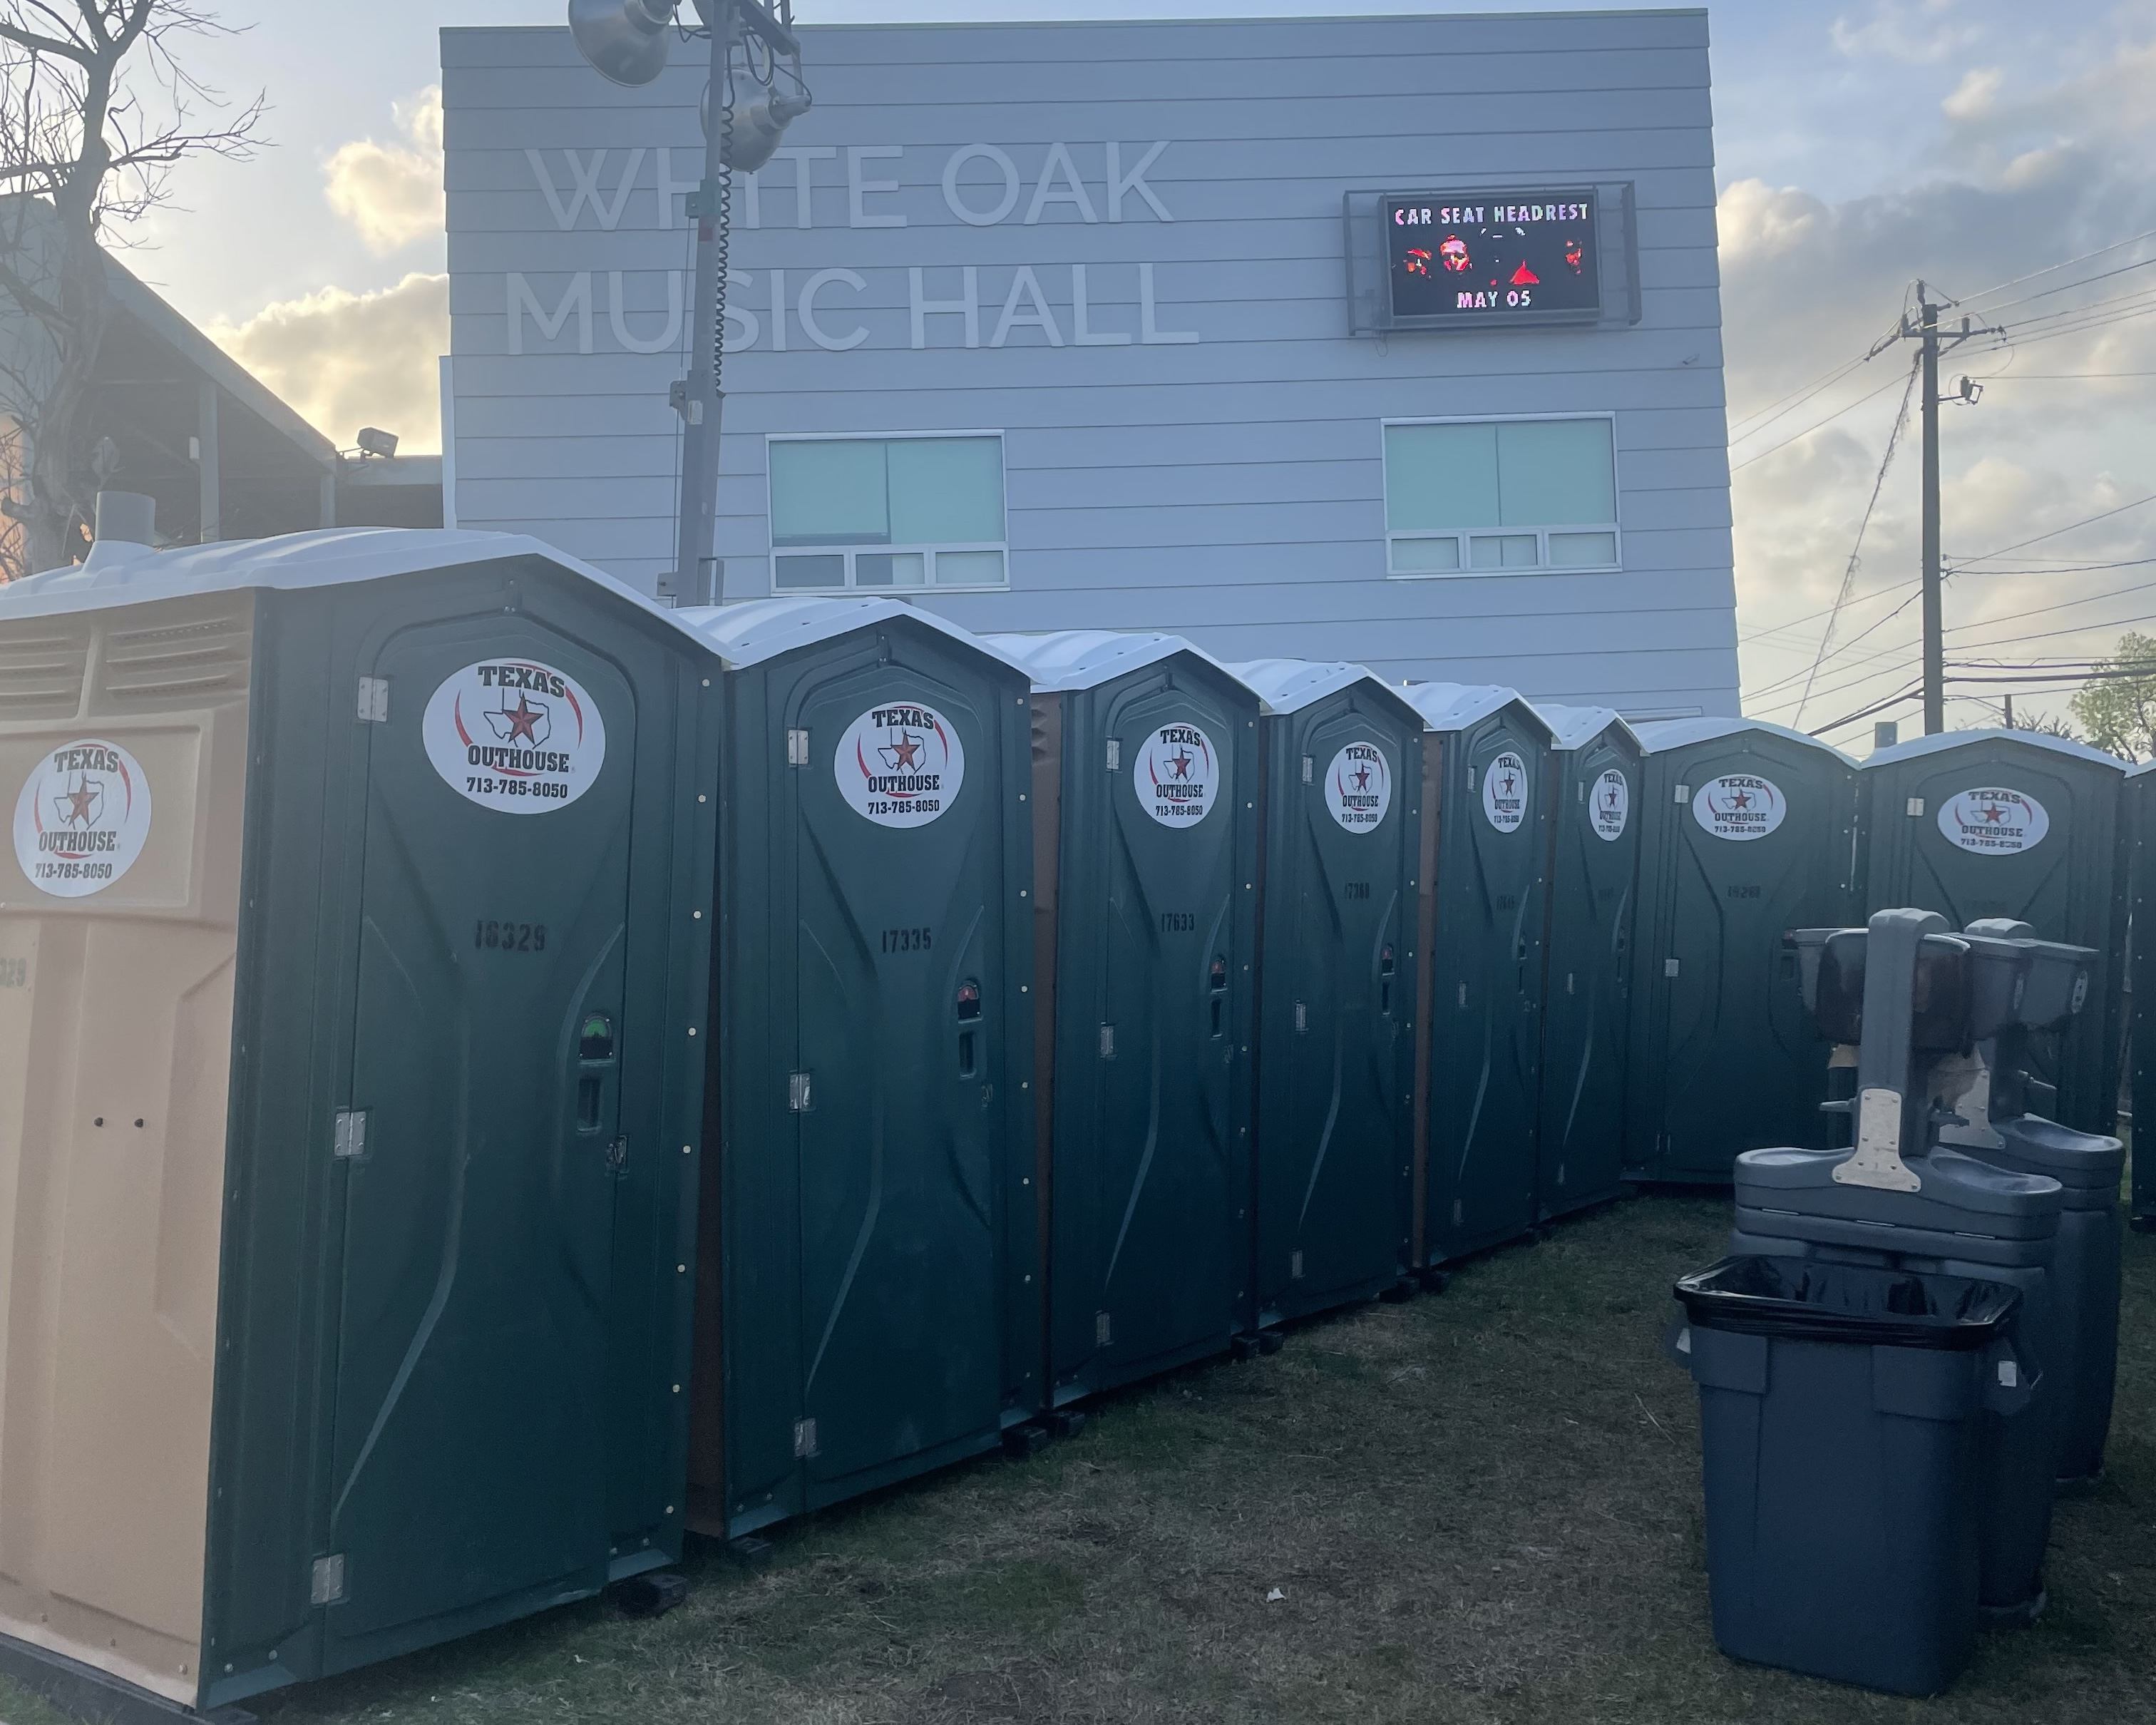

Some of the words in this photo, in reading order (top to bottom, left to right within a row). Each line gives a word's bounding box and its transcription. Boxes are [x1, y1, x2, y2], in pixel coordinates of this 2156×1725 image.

[525, 145, 907, 231] WHITE
[942, 140, 1175, 227] OAK
[1395, 208, 1432, 225] CAR
[1441, 206, 1484, 224] SEAT
[1494, 203, 1588, 222] HEADREST
[909, 262, 1199, 349] HALL
[1457, 291, 1497, 308] MAY
[478, 666, 565, 697] TEXAS
[872, 710, 934, 730] TEXAS
[1160, 729, 1201, 747] TEXAS
[54, 749, 119, 772] TEXAS
[468, 745, 569, 772] OUTHOUSE
[1346, 747, 1377, 762] TEXAS
[466, 777, 568, 799] 713-785-8050
[868, 774, 940, 792] OUTHOUSE
[1156, 784, 1203, 798] OUTHOUSE
[1718, 779, 1763, 789] TEXAS
[868, 799, 940, 814] 713-785-8050
[1343, 795, 1379, 807] OUTHOUSE
[1968, 792, 2021, 804] TEXAS
[1156, 805, 1203, 816] 713-785-8050
[1715, 813, 1767, 821] OUTHOUSE
[1961, 825, 2023, 837] OUTHOUSE
[38, 831, 117, 851] OUTHOUSE
[35, 863, 113, 879] 713-785-8050
[1161, 913, 1194, 932] 17633
[475, 920, 545, 952] 16329
[883, 928, 931, 953] 17335
